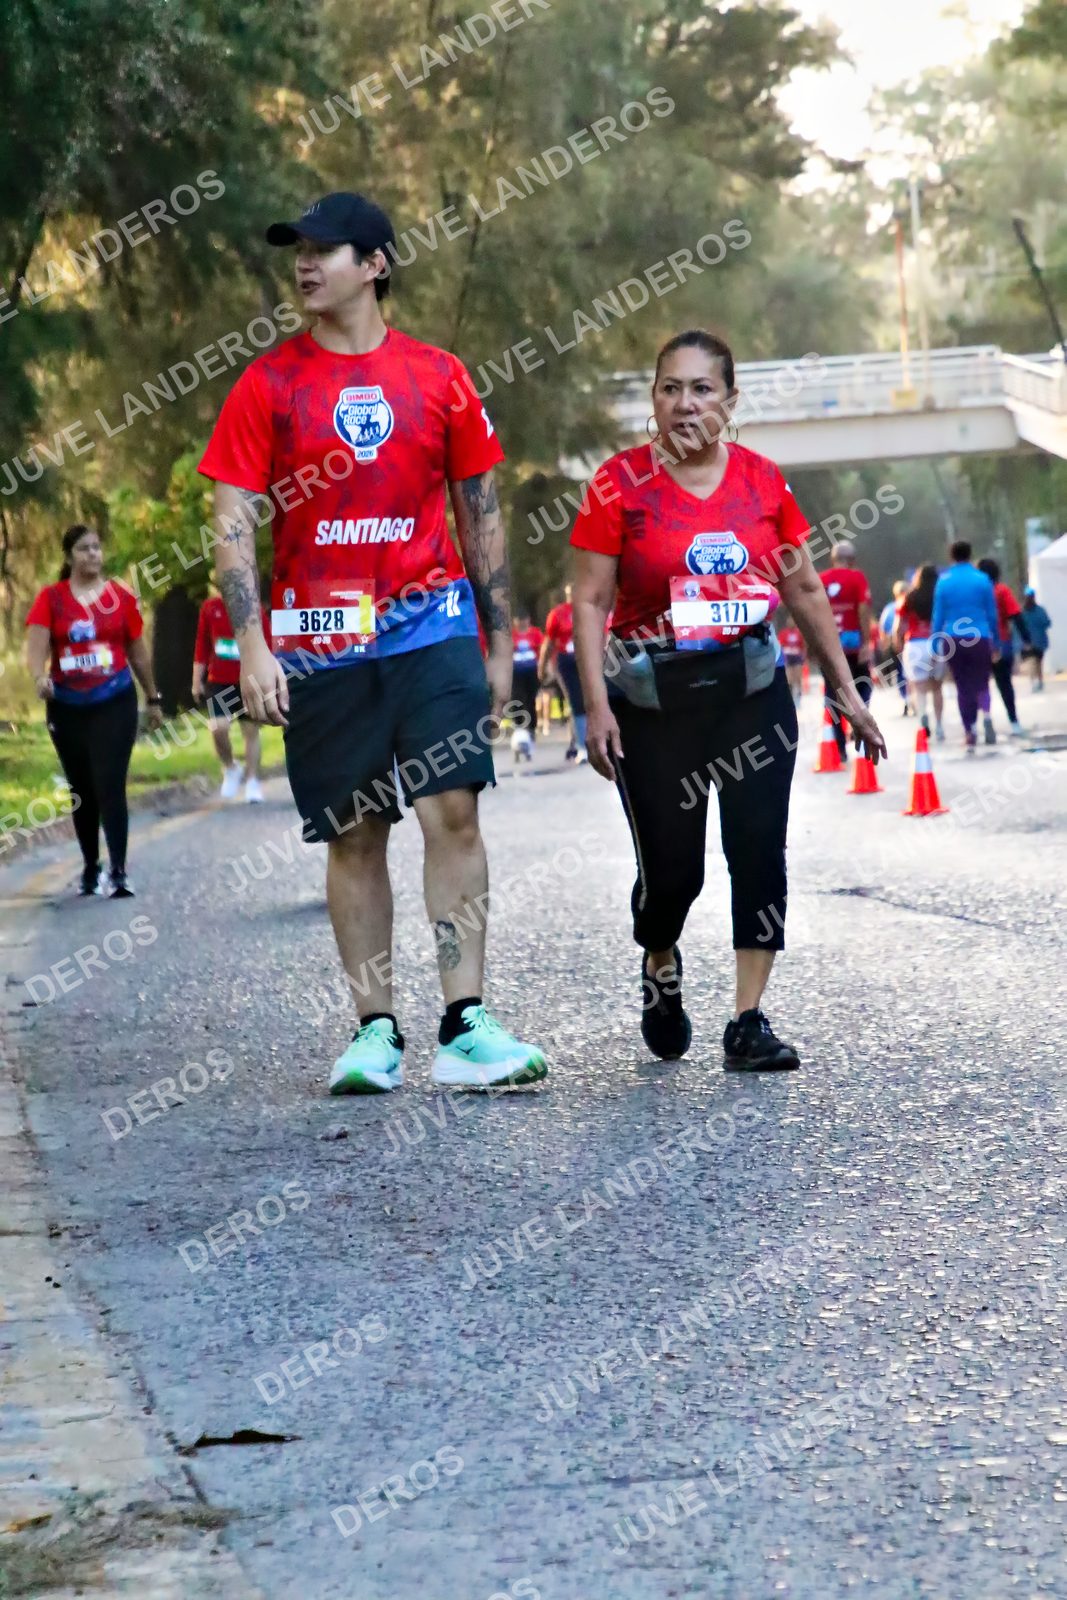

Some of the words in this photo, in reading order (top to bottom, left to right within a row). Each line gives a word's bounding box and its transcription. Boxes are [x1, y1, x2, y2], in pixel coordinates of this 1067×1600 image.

[343, 414, 367, 425] Race
[348, 404, 378, 415] Global
[315, 517, 415, 545] SANTIAGO
[300, 609, 344, 632] 3628
[710, 602, 748, 623] 3171
